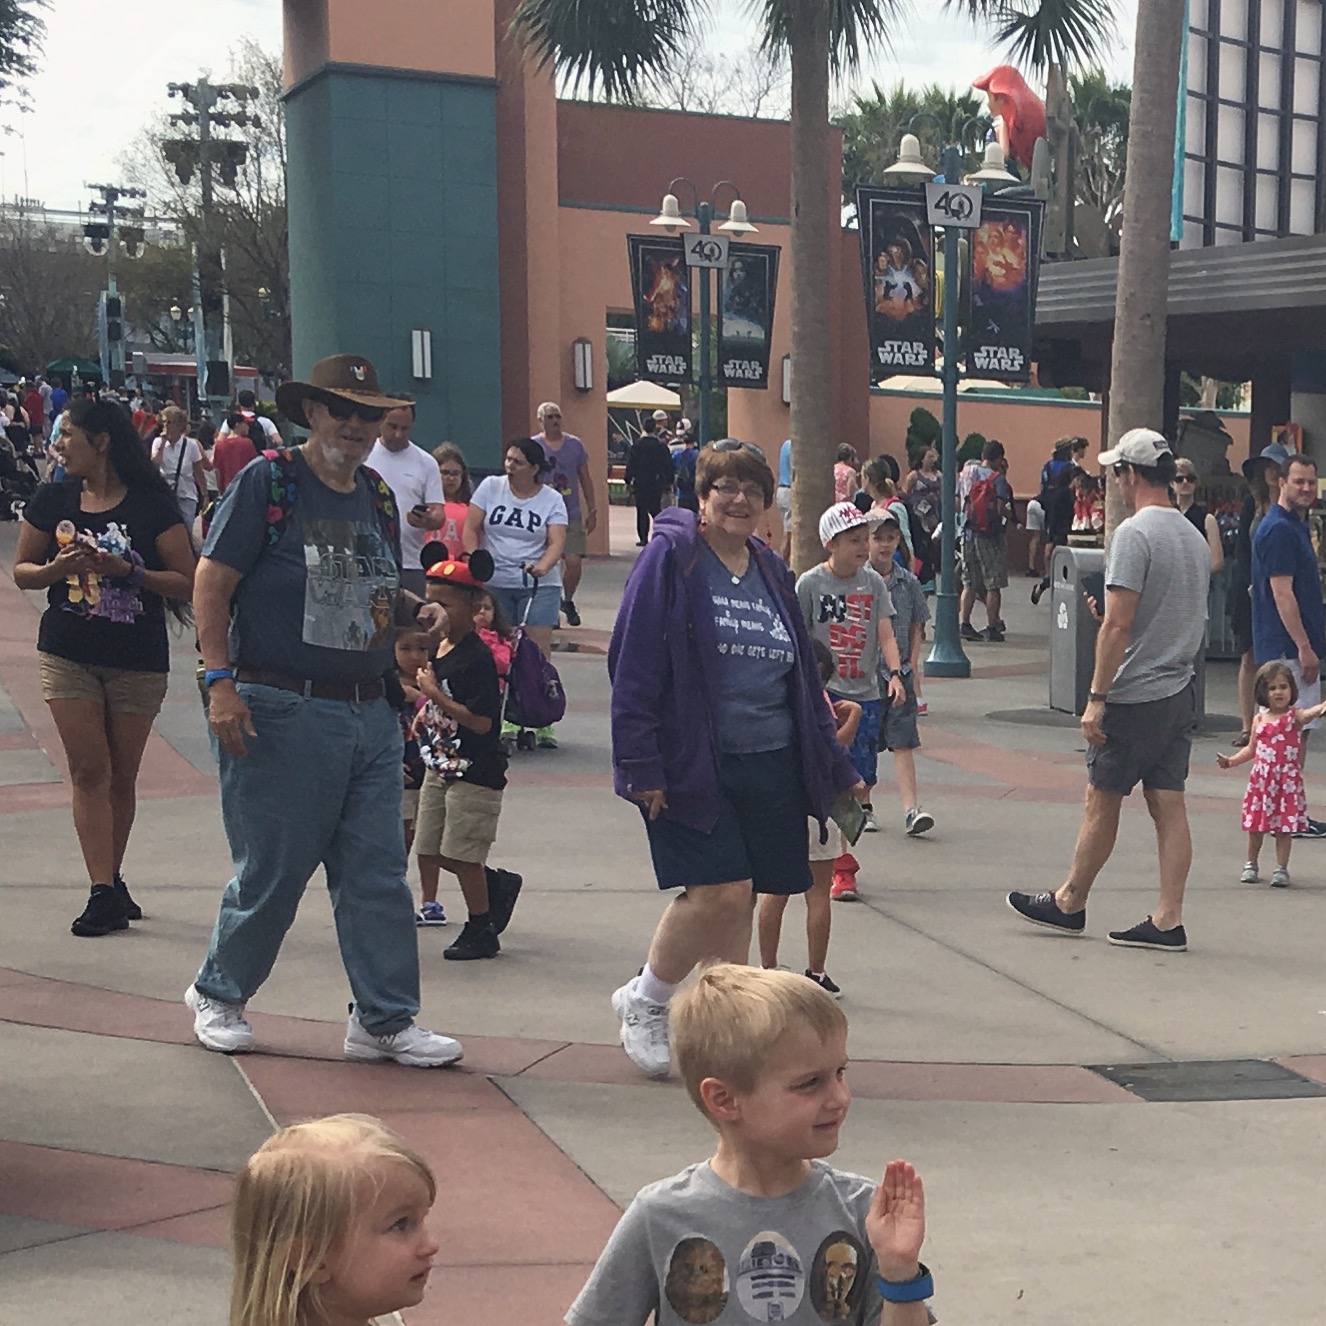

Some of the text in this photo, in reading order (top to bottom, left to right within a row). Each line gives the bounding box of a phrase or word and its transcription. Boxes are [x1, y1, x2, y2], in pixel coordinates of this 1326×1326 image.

[934, 191, 973, 221] 40
[691, 240, 722, 262] 40
[878, 341, 927, 354] STAR
[974, 346, 1023, 360] STAR
[646, 354, 686, 366] STAR
[724, 359, 762, 370] STAR
[878, 352, 927, 366] WARS
[974, 357, 1024, 371] WARS
[647, 362, 687, 375] WARS
[724, 367, 763, 380] WARS
[489, 505, 541, 533] GAP
[818, 594, 874, 623] JUST
[829, 624, 867, 650] DO
